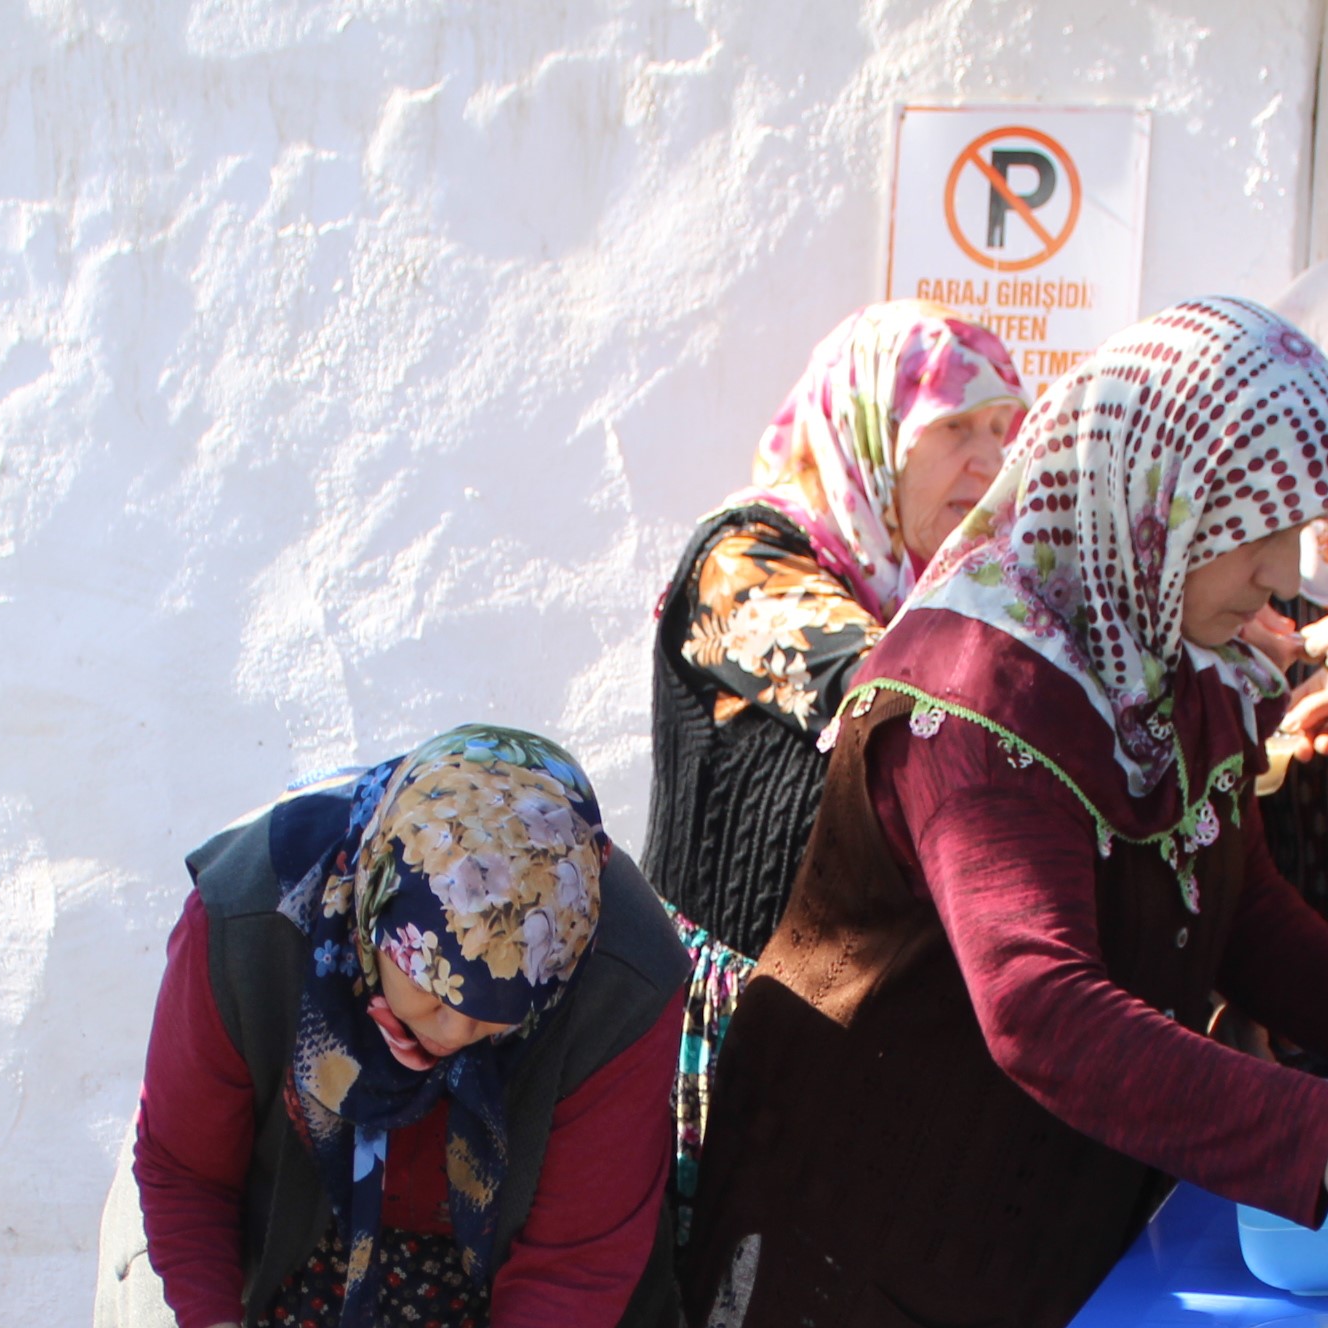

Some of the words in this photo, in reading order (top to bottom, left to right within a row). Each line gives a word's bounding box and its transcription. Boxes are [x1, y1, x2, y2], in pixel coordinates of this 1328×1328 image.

[986, 147, 1057, 249] P
[916, 277, 989, 306] GARAJ
[996, 276, 1093, 312] GİRİŞİDİ
[968, 308, 1049, 342] ÜTFEN
[1022, 348, 1096, 376] ETME
